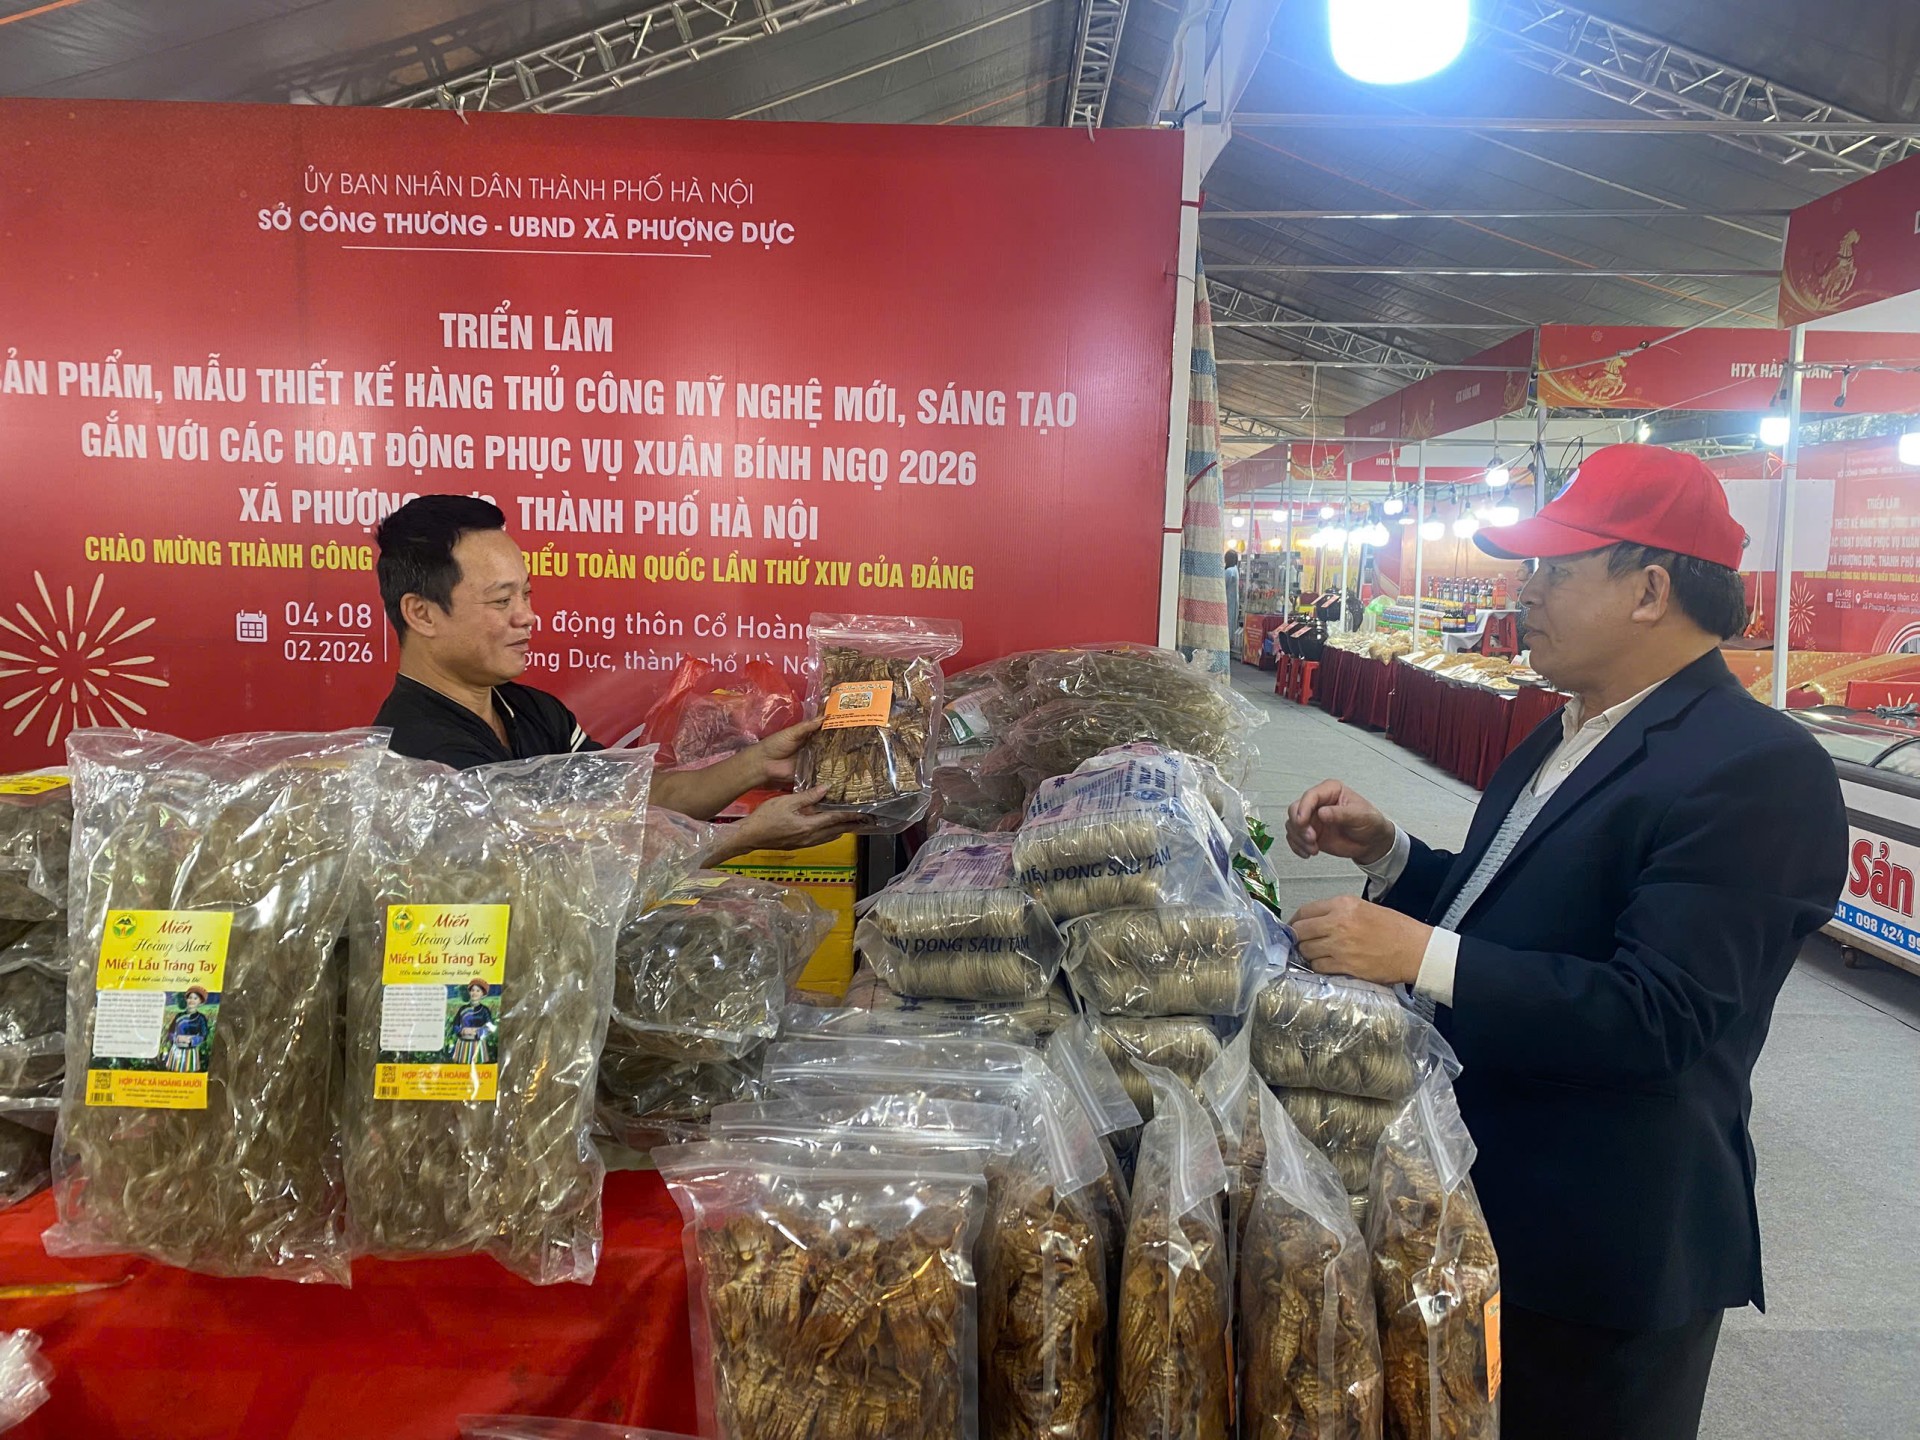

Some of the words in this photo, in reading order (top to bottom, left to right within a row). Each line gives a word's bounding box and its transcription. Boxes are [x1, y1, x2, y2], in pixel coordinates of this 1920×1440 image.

[305, 165, 333, 193] ỦY
[341, 173, 387, 195] BAN
[396, 171, 462, 196] NHÂN
[471, 172, 521, 198] DÂN
[529, 174, 604, 200] THÀNH
[614, 173, 662, 201] PHỐ
[672, 177, 703, 202] HÀ
[712, 178, 752, 208] NỘI
[259, 202, 291, 230] SỞ
[300, 206, 376, 233] CÔNG
[384, 211, 487, 235] THƯƠNG
[510, 216, 575, 237] UBND
[584, 213, 618, 239] XÃ
[628, 217, 733, 247] PHƯỢNG
[742, 220, 794, 249] DỰC
[439, 300, 532, 350] TRIỂN
[545, 309, 612, 352] LÃM
[1731, 363, 1756, 378] HTX
[0, 348, 47, 395] ẢN
[58, 349, 162, 404] PHẨM,
[174, 353, 246, 402] MẪU
[257, 359, 343, 406] THIẾT
[354, 361, 395, 406] KẾ
[406, 366, 492, 409] HÀNG
[504, 365, 564, 411] THỦ
[576, 371, 664, 414] CÔNG
[677, 375, 725, 416] MỸ
[737, 378, 822, 428] NGHỆ
[835, 380, 905, 427] MỚI,
[917, 382, 1005, 425] SÁNG
[1017, 390, 1080, 434] TẠO
[82, 410, 147, 458] GẮN
[157, 419, 208, 460] VỚI
[220, 421, 283, 463] CÁC
[295, 430, 376, 473] HOẠT
[385, 426, 473, 475] ĐỘNG
[486, 436, 570, 479] PHỤC
[582, 439, 622, 481] VỤ
[634, 435, 722, 477] XUÂN
[734, 437, 810, 480] BÍNH
[823, 447, 888, 490] NGỌ
[899, 450, 976, 485] 2026
[1376, 458, 1390, 466] HKD
[239, 482, 282, 523] XÃ
[293, 488, 420, 533] PHƯỢN
[517, 495, 622, 532] THÀNH
[635, 491, 700, 537] PHỐ
[711, 496, 752, 538] HÀ
[764, 498, 818, 547] NỘI
[85, 536, 146, 562] CHÀO
[153, 538, 221, 567] MỪNG
[228, 539, 303, 569] THÀNH
[311, 540, 373, 570] CÔNG
[576, 550, 636, 579] TOÀN
[644, 548, 704, 582] QUỐC
[713, 549, 757, 584] LẦN
[765, 555, 807, 586] THỨ
[815, 561, 850, 587] XIV
[858, 554, 903, 588] CỦA
[911, 556, 974, 590] ĐẢNG
[285, 601, 319, 626] 04
[338, 604, 372, 629] 08
[552, 610, 615, 639] động
[626, 611, 683, 636] thôn
[694, 612, 727, 637] Cổ
[284, 640, 373, 663] 02.2026
[569, 650, 616, 673] Dực,
[697, 652, 737, 673] hố
[1053, 863, 1102, 882] DONG
[1107, 855, 1142, 876] SÁU
[1145, 845, 1172, 871] TÁM
[1849, 839, 1914, 918] Sản
[157, 919, 194, 934] Miến
[432, 913, 470, 928] Miến
[1835, 904, 1847, 919] H
[1856, 912, 1878, 933] 098
[1881, 923, 1905, 944] 424
[914, 938, 963, 952] DONG
[968, 935, 1001, 952] SÁU
[1007, 933, 1030, 952] TÁM
[105, 957, 135, 970] Miến
[138, 957, 160, 971] Lẩu
[163, 959, 195, 974] Tráng
[198, 959, 218, 974] Tay
[388, 951, 414, 965] Miến
[418, 950, 438, 964] Lẩu
[441, 952, 474, 966] Tráng
[479, 952, 498, 966] Tay
